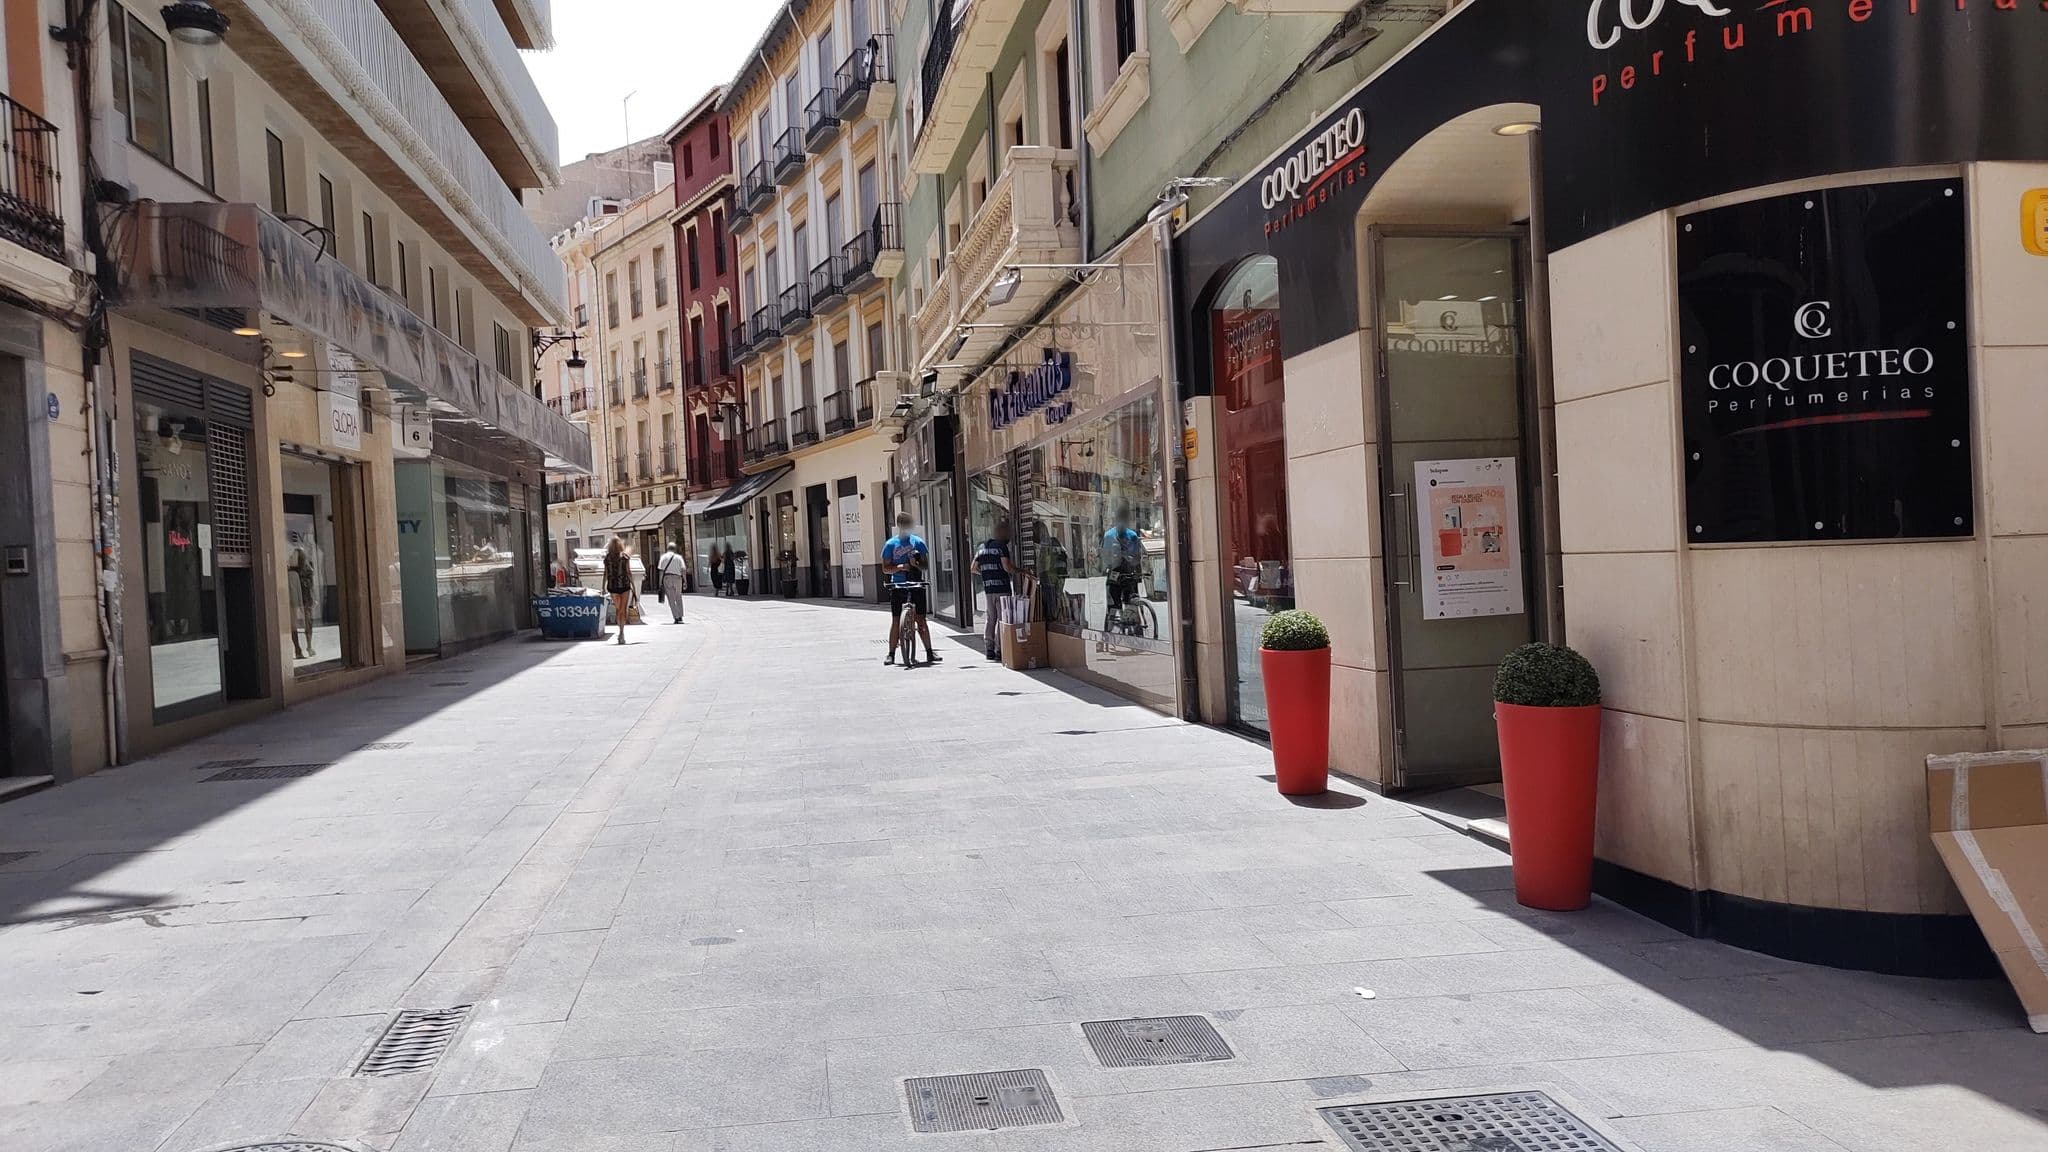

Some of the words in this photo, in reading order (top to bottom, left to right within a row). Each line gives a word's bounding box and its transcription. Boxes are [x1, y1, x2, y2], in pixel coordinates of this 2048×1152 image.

[1592, 0, 2048, 105] Perfume
[1262, 107, 1365, 209] COQUETEO
[1708, 347, 1934, 391] COQUETEO
[1708, 386, 1934, 413] Perfumerias
[412, 430, 421, 442] 6
[555, 606, 599, 618] 133344
